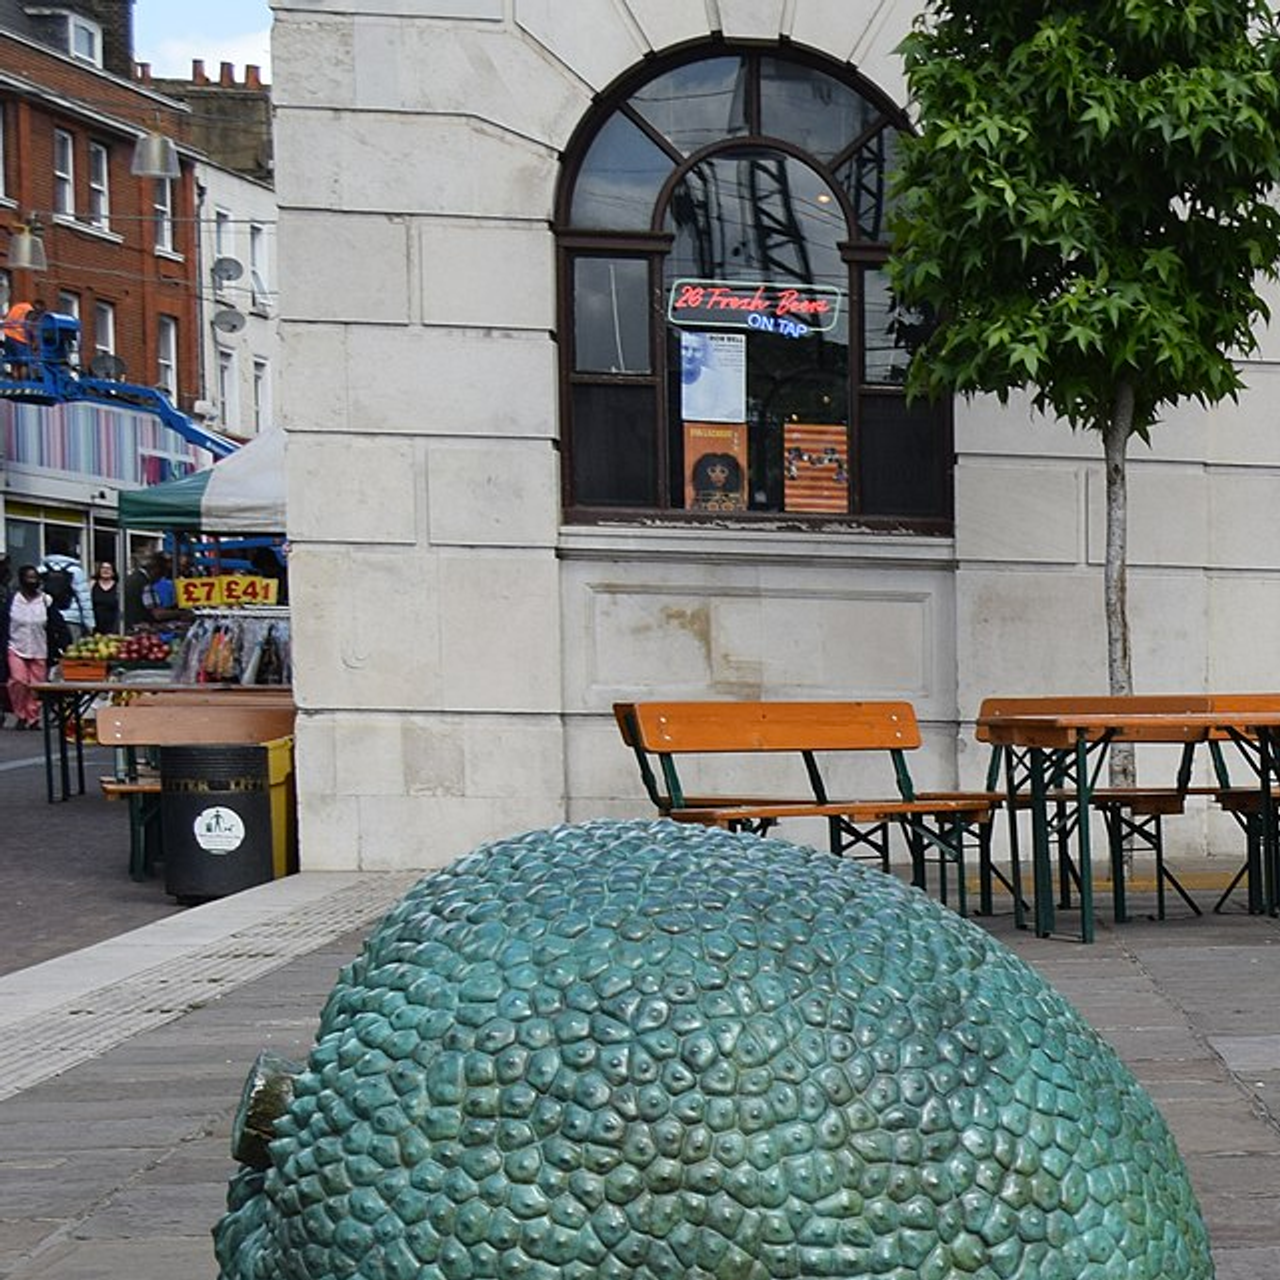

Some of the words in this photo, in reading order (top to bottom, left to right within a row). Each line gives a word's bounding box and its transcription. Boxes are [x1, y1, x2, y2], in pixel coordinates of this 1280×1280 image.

[706, 286, 770, 312] Fresh
[775, 289, 831, 315] Beers
[748, 313, 775, 332] ON
[778, 319, 808, 338] TAP
[183, 582, 215, 602] £7
